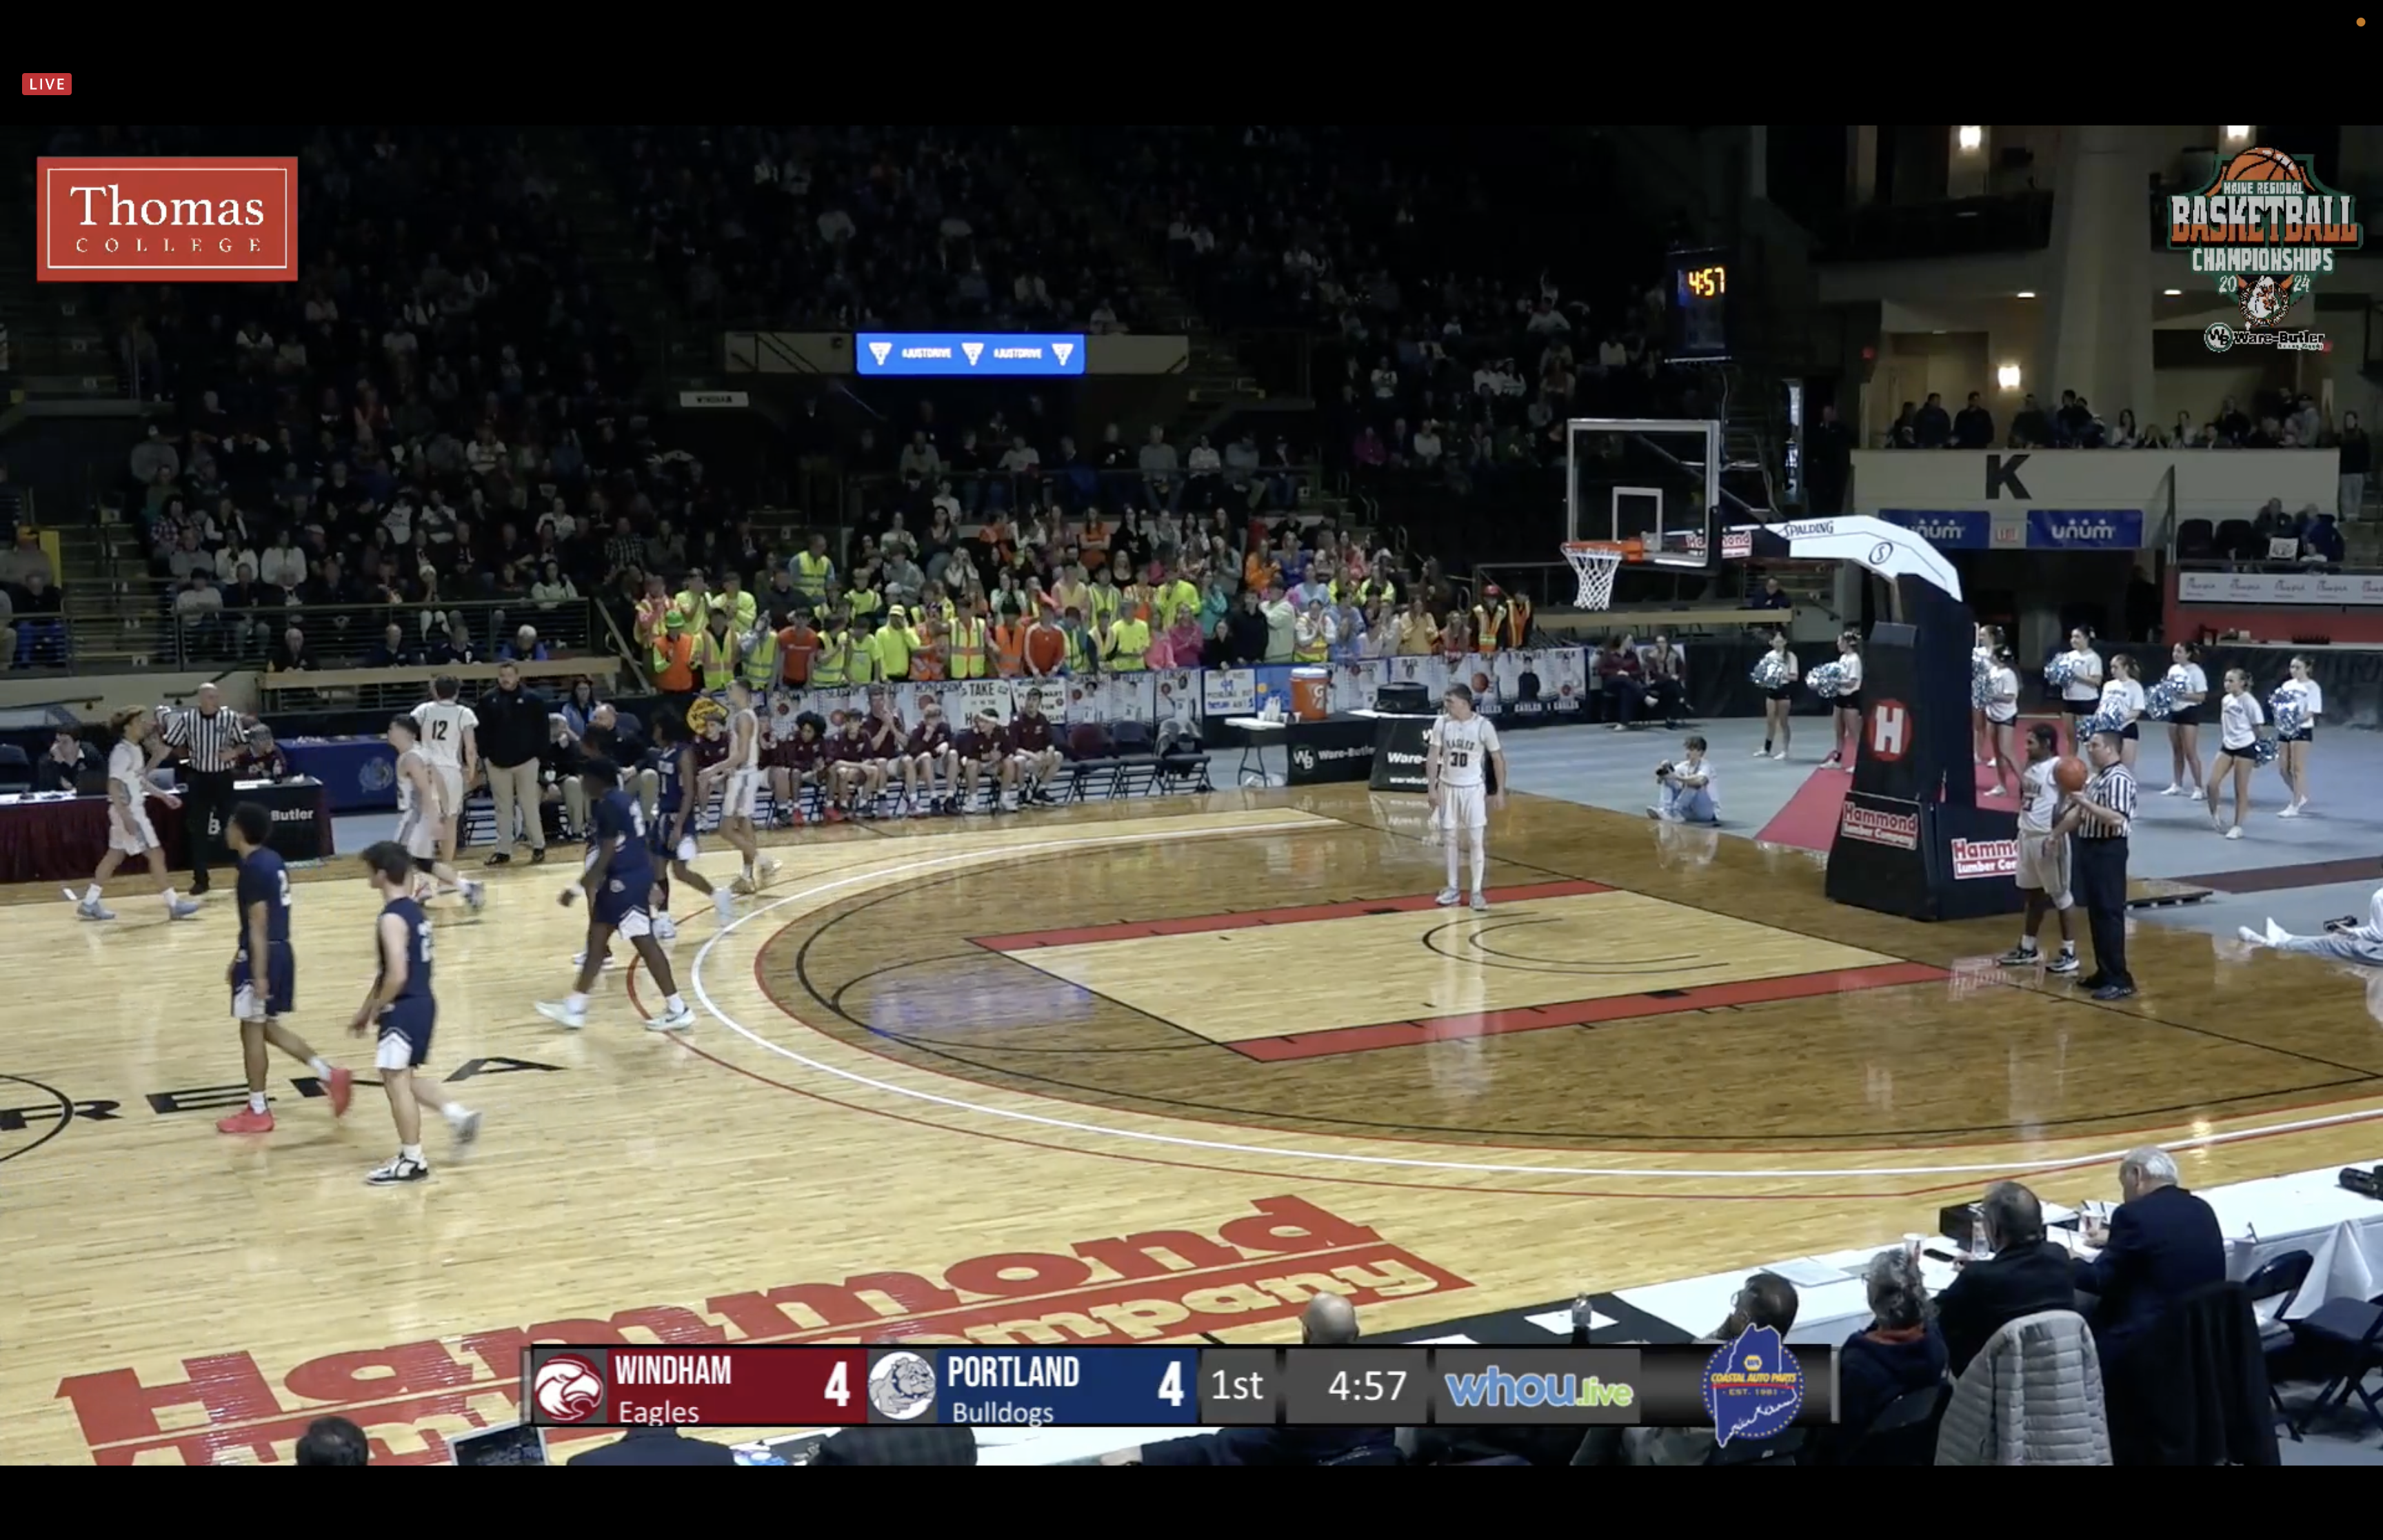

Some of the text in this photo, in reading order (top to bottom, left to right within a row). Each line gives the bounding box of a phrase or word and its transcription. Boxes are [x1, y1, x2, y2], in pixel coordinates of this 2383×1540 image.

[1689, 267, 1725, 296] 4:57
[1985, 454, 2032, 500] K
[1783, 520, 1834, 538] SPALDING
[2051, 520, 2115, 539] unum
[969, 682, 995, 696] TAKE
[432, 719, 448, 740] 12
[1874, 705, 1903, 755] H
[1318, 745, 1376, 760] Ware-Butler
[1387, 752, 1427, 764] Ware-
[1450, 751, 1468, 767] 30
[270, 808, 314, 821] Butler
[1844, 802, 1918, 831] Hammond
[1957, 861, 1996, 874] Lumber
[54, 1195, 1385, 1447] Hammond
